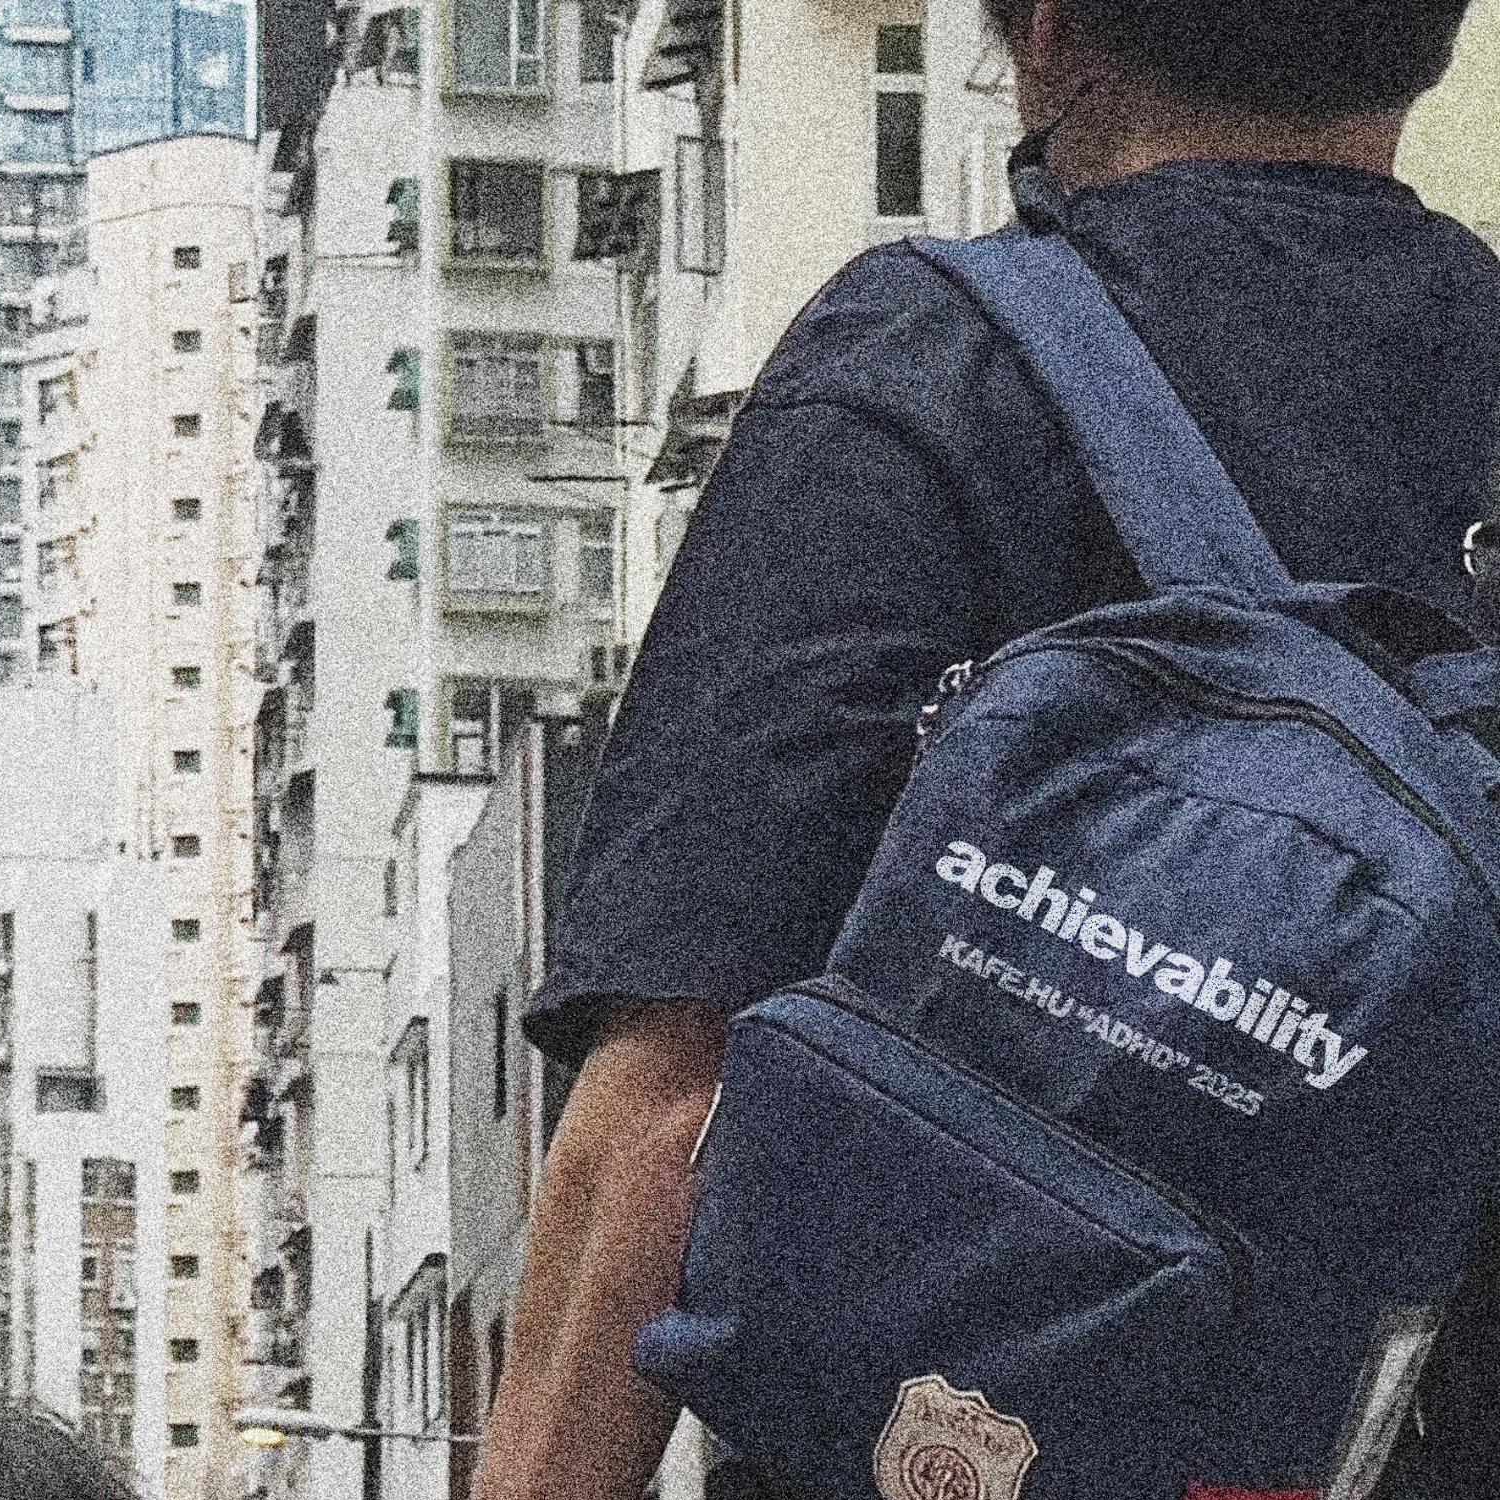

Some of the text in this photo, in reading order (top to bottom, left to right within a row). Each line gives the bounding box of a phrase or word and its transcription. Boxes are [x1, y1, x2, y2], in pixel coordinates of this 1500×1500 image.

[936, 840, 1368, 1090] achievability
[938, 935, 1074, 1018] KAFE.HU
[1187, 1065, 1266, 1117] 2025
